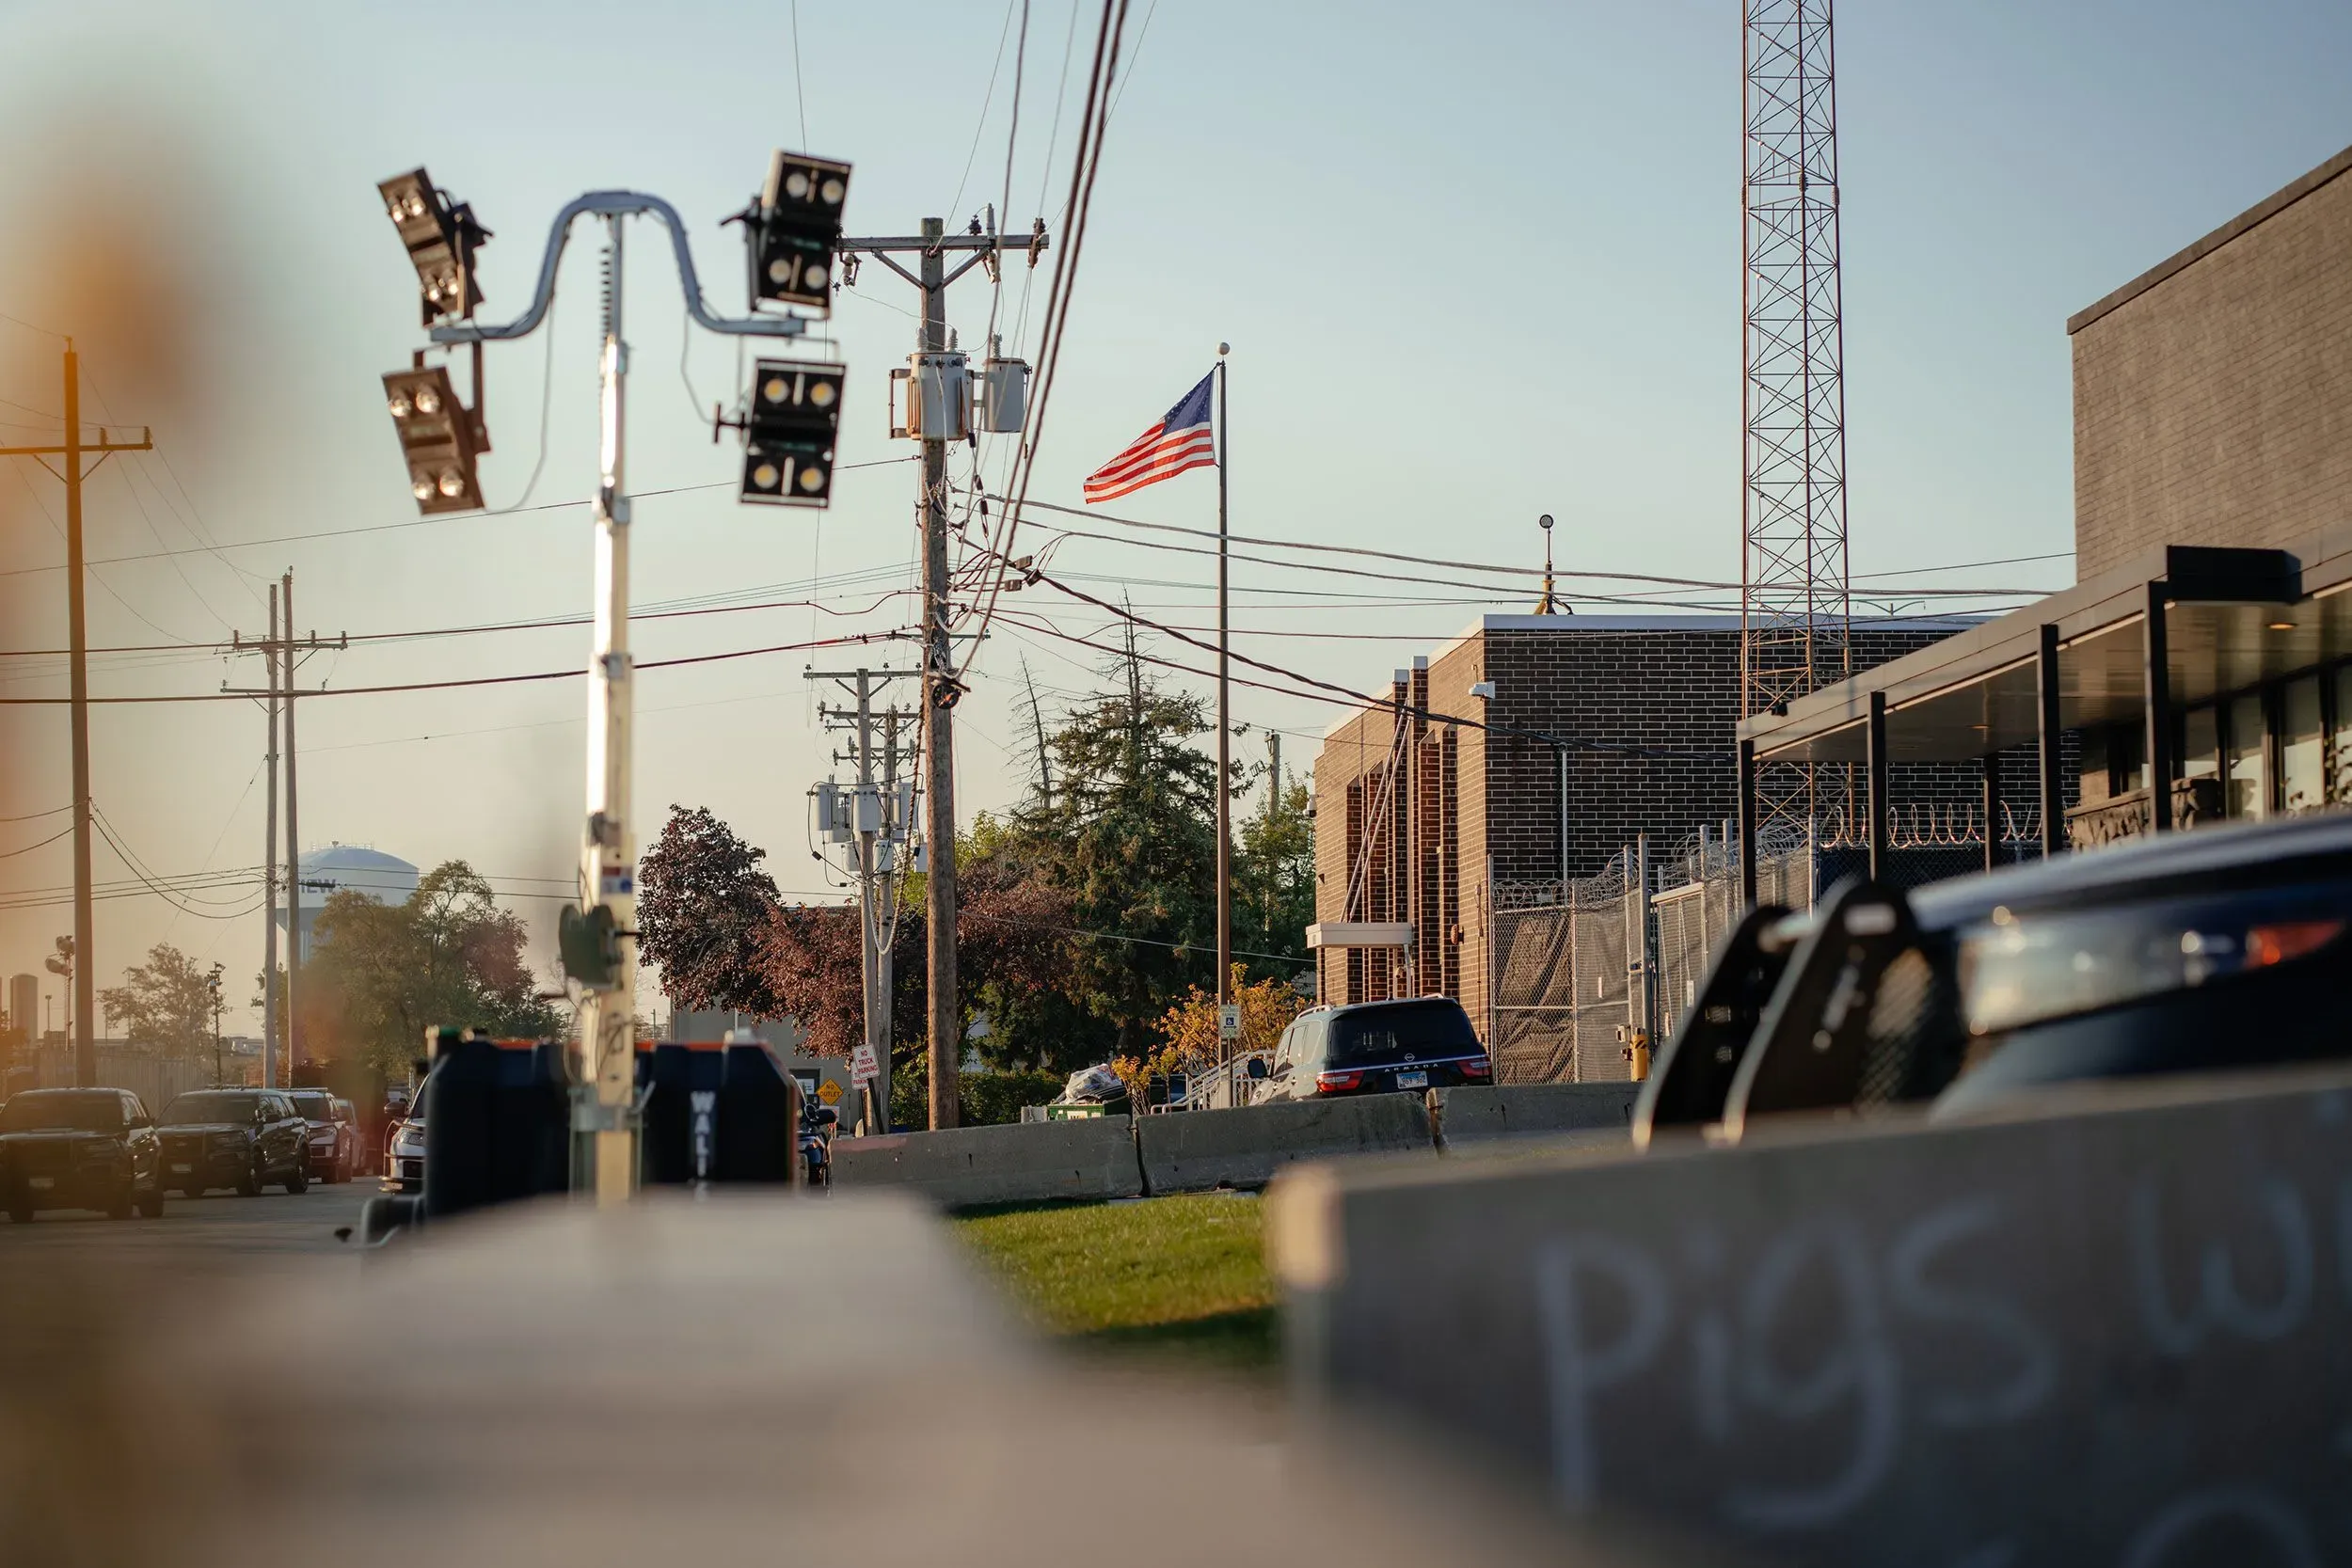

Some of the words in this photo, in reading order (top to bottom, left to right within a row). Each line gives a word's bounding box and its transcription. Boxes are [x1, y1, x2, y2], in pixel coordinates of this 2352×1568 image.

[858, 1057, 873, 1066] TRUCK
[858, 1065, 878, 1074] PARKING
[1384, 1063, 1438, 1072] ARMADA
